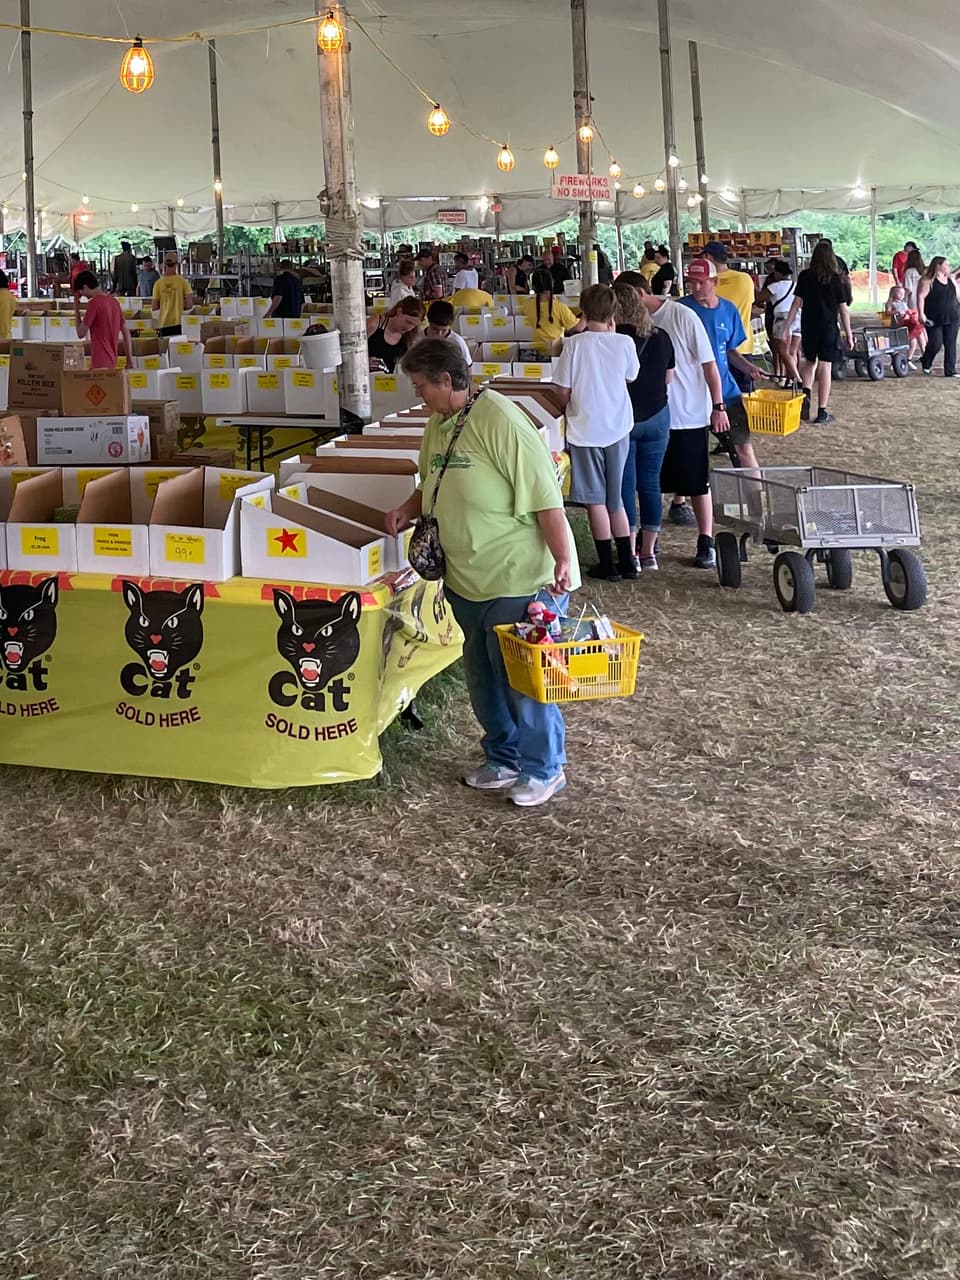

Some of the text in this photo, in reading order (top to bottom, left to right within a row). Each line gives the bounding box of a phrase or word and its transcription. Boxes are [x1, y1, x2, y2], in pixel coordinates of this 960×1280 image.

[557, 187, 611, 199] NO SMOKING
[559, 175, 609, 187] FIREWORKS
[120, 662, 196, 700] Cat
[268, 670, 352, 713] Cat
[20, 698, 60, 718] HERE
[115, 702, 201, 728] SOLD HERE
[265, 713, 358, 742] SOLD HERE
